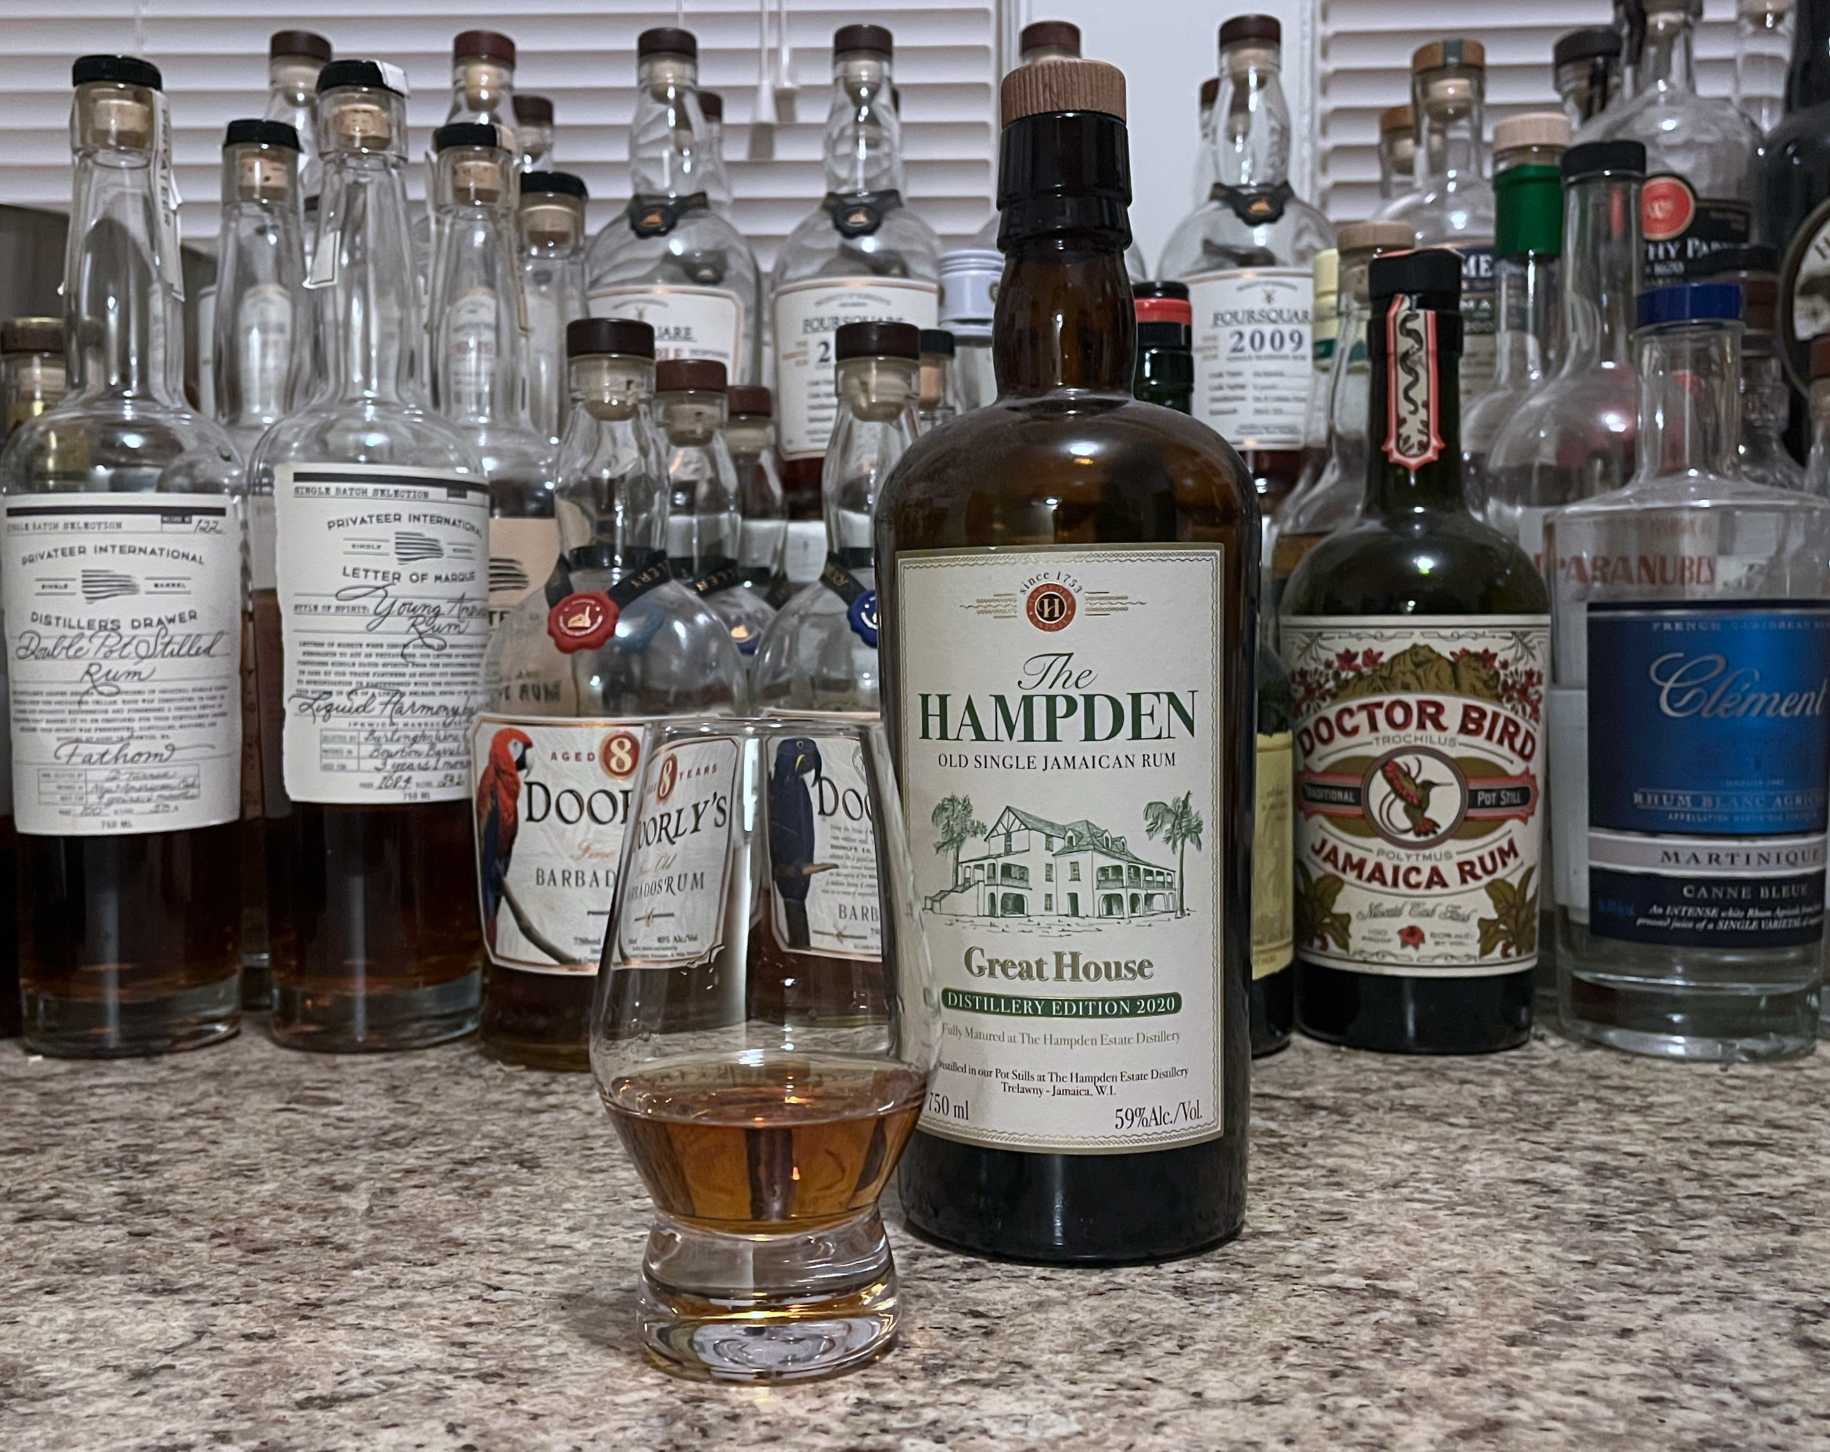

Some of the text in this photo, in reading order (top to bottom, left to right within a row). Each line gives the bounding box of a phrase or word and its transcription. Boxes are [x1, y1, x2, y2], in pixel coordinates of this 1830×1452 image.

[1212, 309, 1310, 327] FOURSQUAR
[1230, 329, 1304, 353] 2009
[372, 488, 429, 499] SELECTION
[63, 520, 123, 531] SELECTION
[327, 514, 402, 532] PRIVATEER
[21, 544, 205, 566] PRIVATEER INTERNATIONAL
[342, 565, 476, 585] LETTER OF MARQUE
[1020, 571, 1083, 595] since 1753
[30, 609, 198, 632] DISTILLERS DRAWER
[1017, 652, 1097, 690] The
[1649, 651, 1828, 719] Clément
[291, 692, 376, 724] Liquid
[918, 690, 1199, 742] HAMPDEN
[1297, 699, 1537, 763] DOCTOR BIRD
[1372, 734, 1458, 748] TROCHILUS
[54, 736, 177, 766] Fathom
[550, 752, 596, 762] AGED
[609, 738, 633, 773] 8
[938, 752, 1176, 772] OLD SINGLE JAMAICAN RUM
[659, 760, 718, 797] 8 YEARS
[638, 792, 727, 850] ORLY'S
[1311, 838, 1520, 890] JAMAICA RUM
[1376, 848, 1453, 862] POLYTMUS
[1660, 849, 1818, 867] MARTINIQUE
[535, 867, 616, 889] BARBAD
[1683, 884, 1752, 899] CANNE
[838, 903, 880, 922] BARB
[1666, 904, 1720, 918] INTENSE
[1716, 918, 1759, 931] SINGLE
[964, 946, 1154, 982] Great House
[948, 991, 1176, 1016] DISTILLERY EDITION 2020
[941, 1023, 1181, 1050] Fully Matured at The Hampden Estate Distillery
[968, 1067, 977, 1075] in
[978, 1069, 992, 1078] our
[995, 1068, 1009, 1080] Pot
[1012, 1070, 1035, 1082] Stills
[1036, 1074, 1046, 1083] at
[1047, 1071, 1067, 1083] The
[1070, 1072, 1118, 1087] Hampden
[1120, 1071, 1148, 1082] Estate
[1150, 1066, 1189, 1080] Distillery
[1001, 1082, 1043, 1098] Trelawny
[929, 1093, 969, 1120] 750 ml
